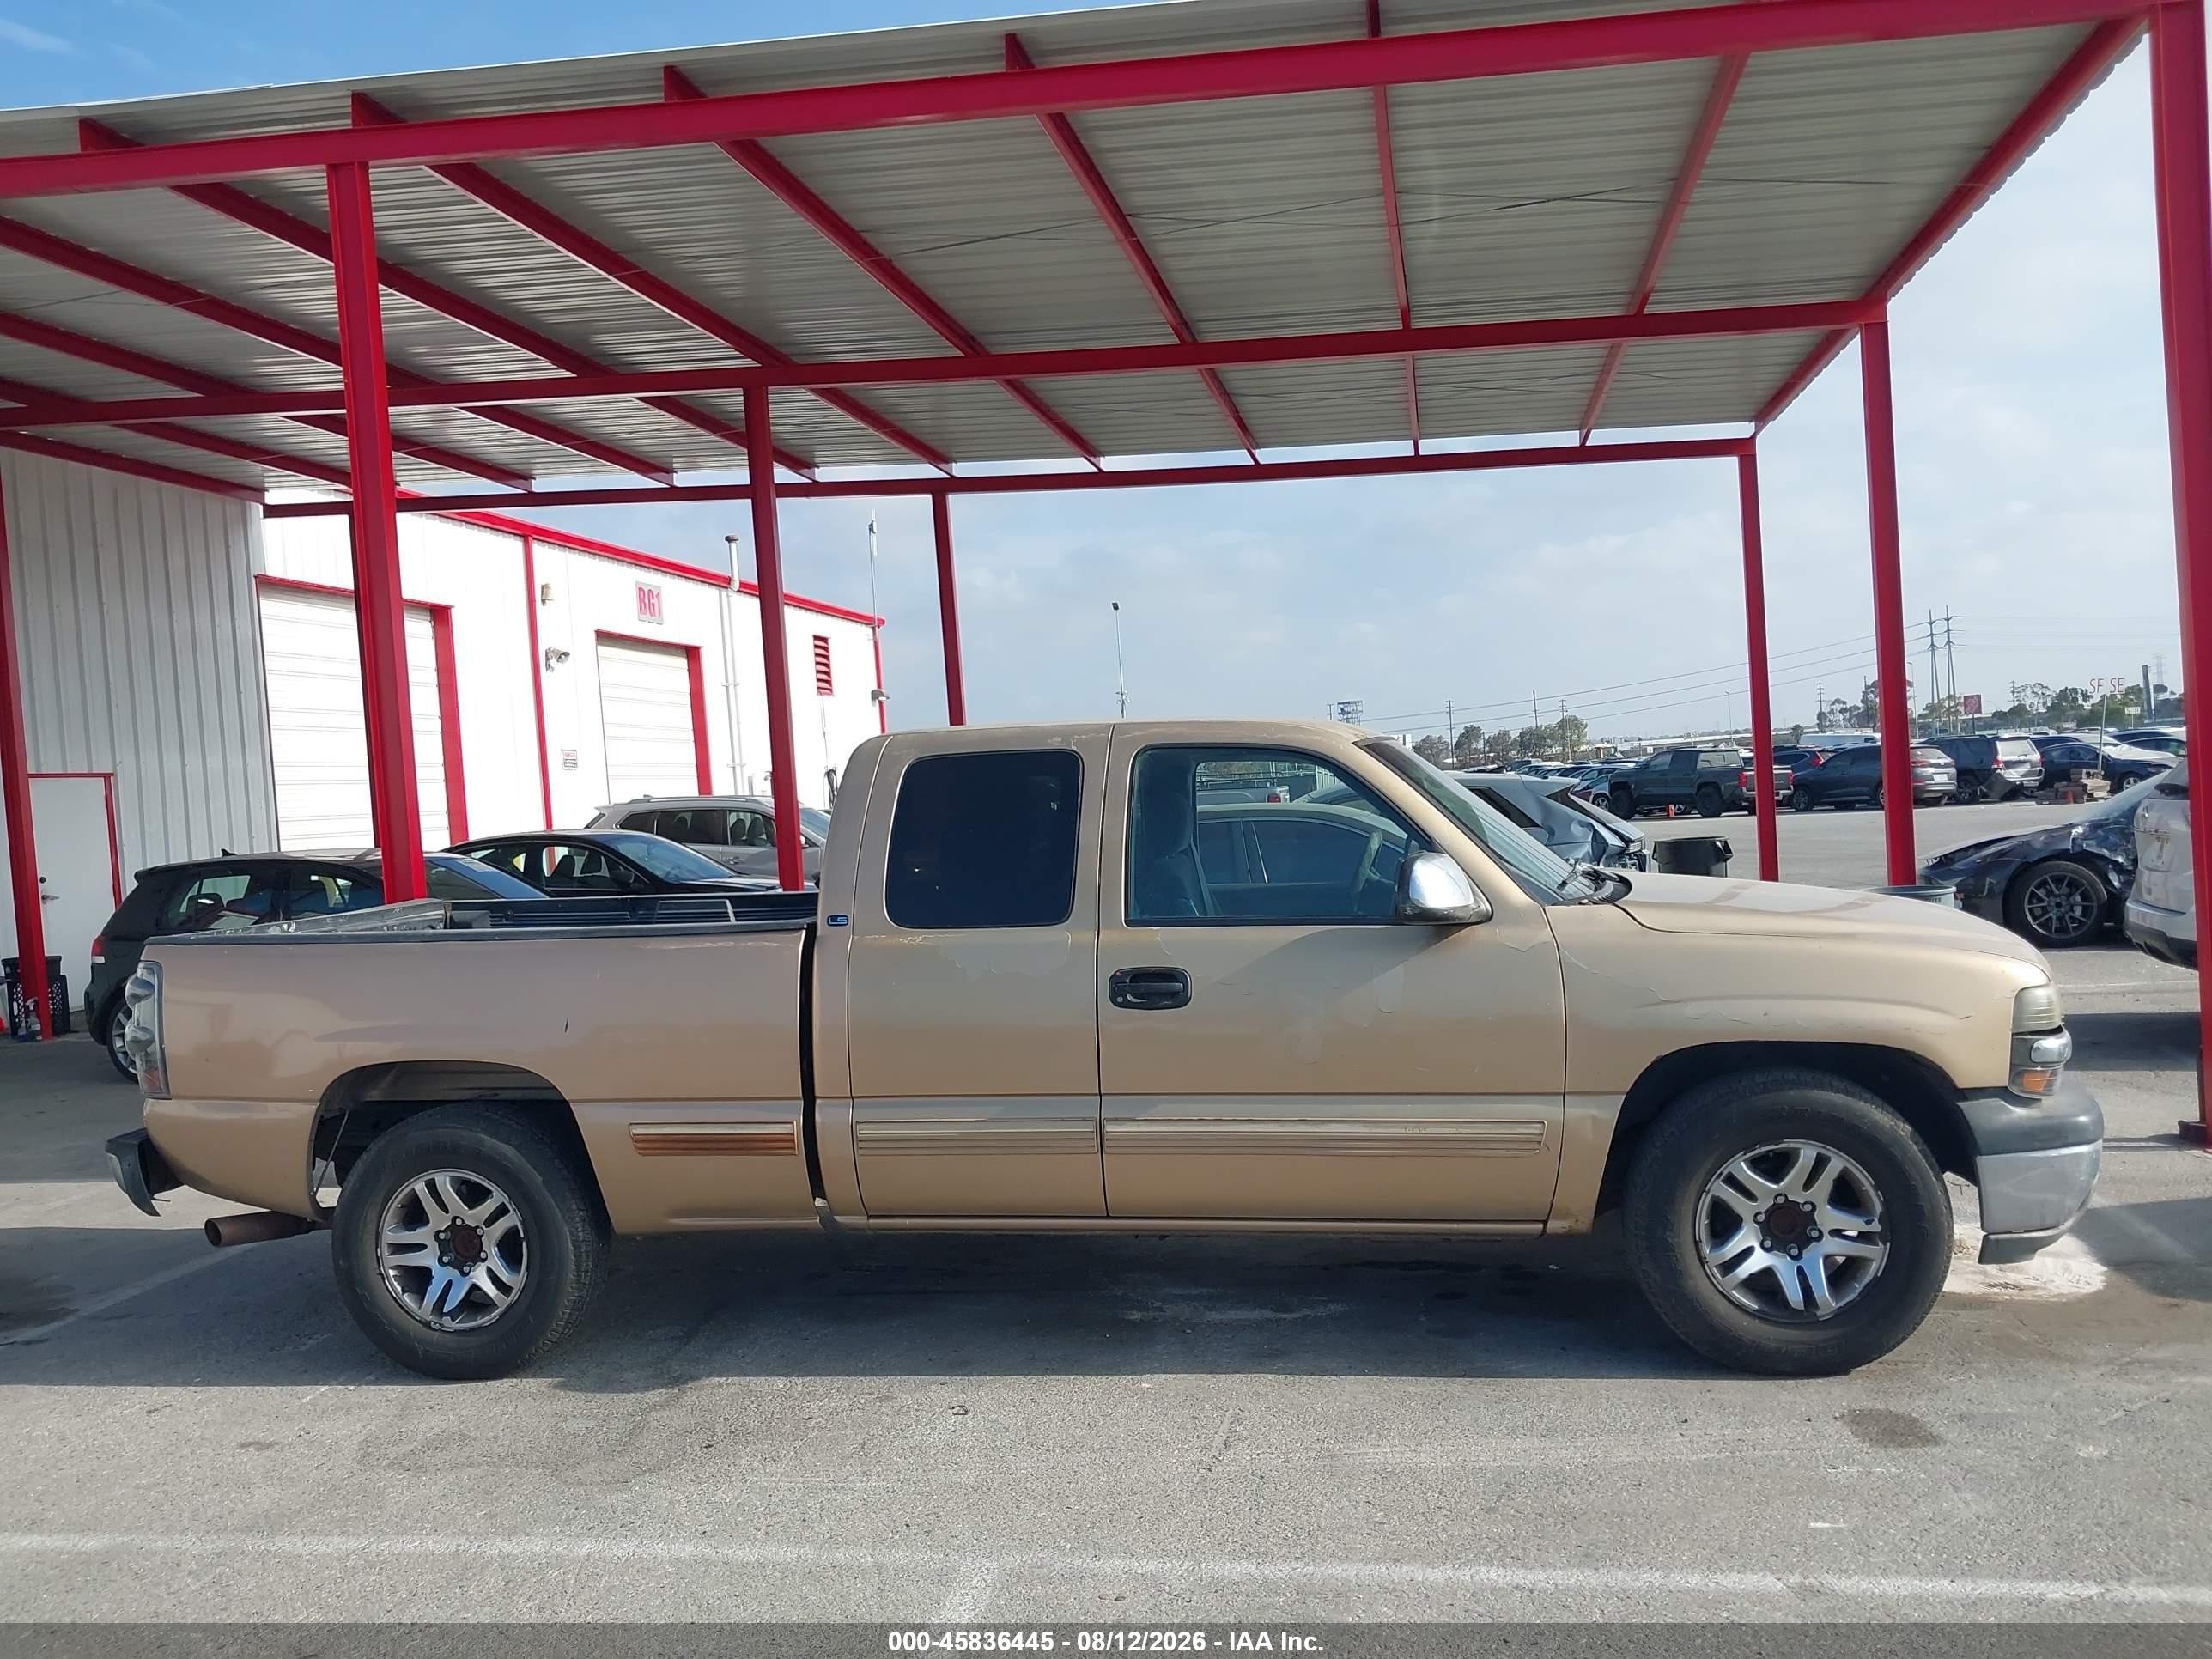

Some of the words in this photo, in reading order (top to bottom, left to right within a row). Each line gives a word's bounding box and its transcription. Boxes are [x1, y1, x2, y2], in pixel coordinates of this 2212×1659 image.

[2089, 678, 2104, 694] SF
[2109, 677, 2124, 693] SE
[829, 916, 848, 925] LS
